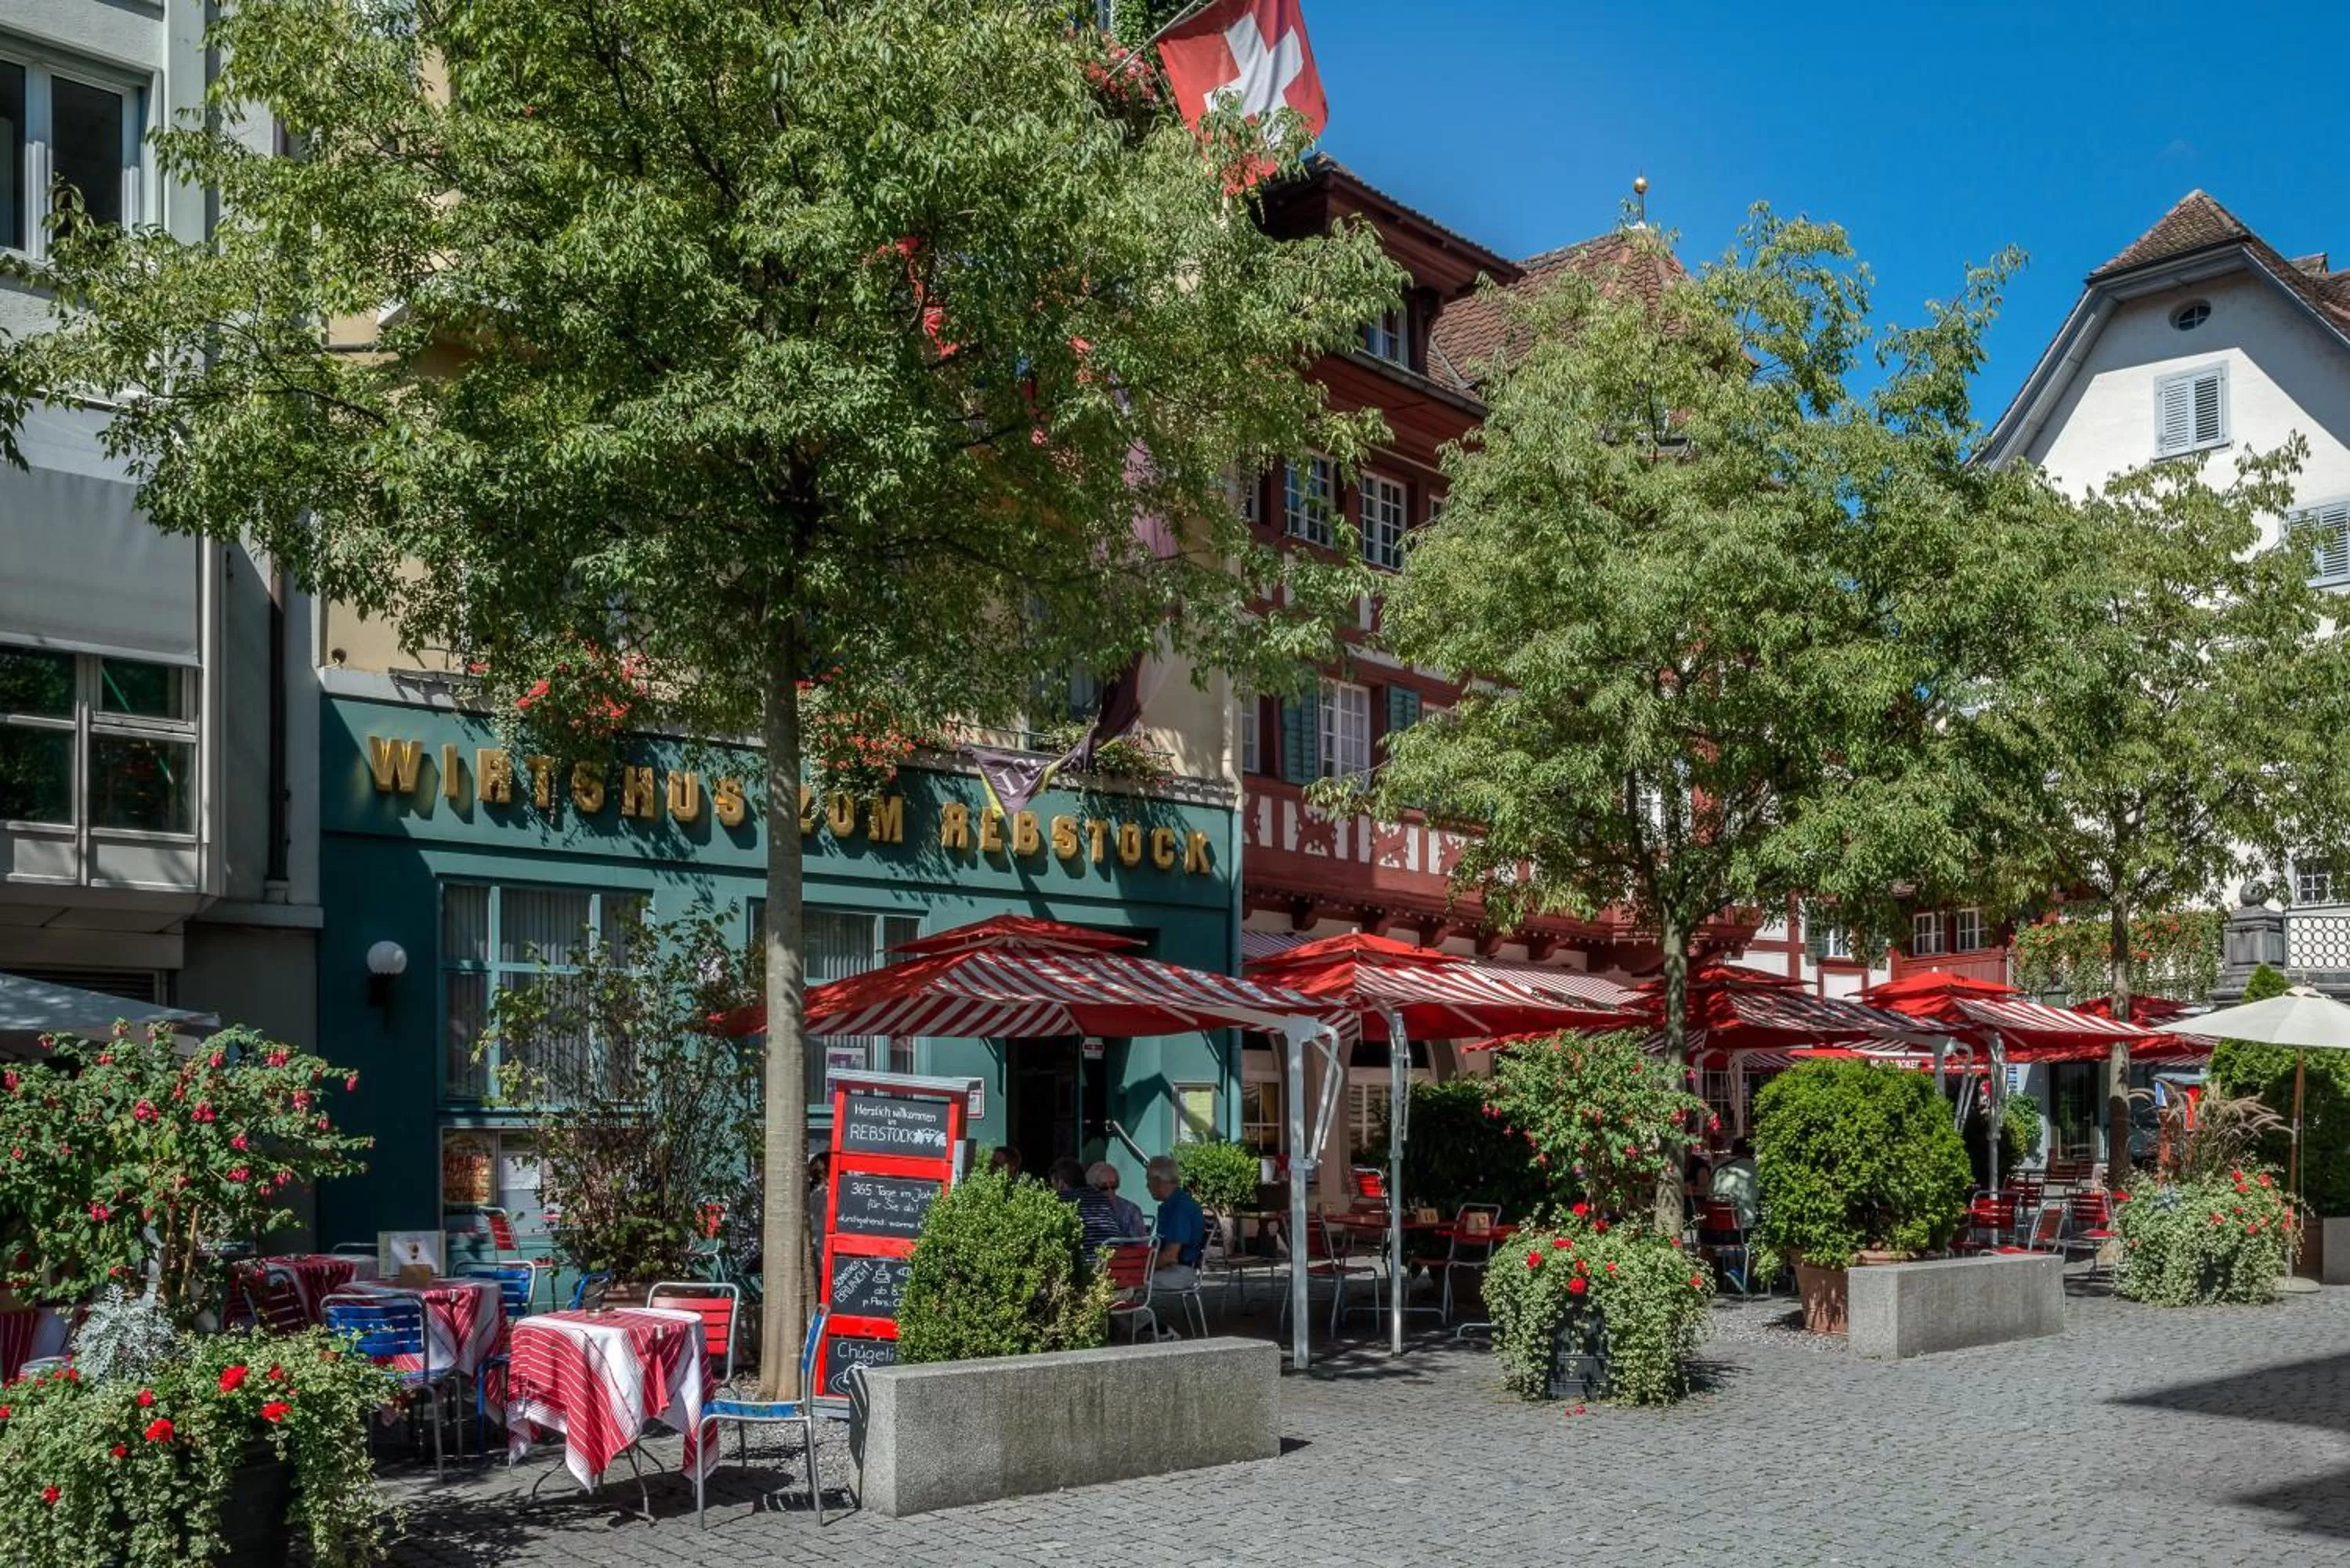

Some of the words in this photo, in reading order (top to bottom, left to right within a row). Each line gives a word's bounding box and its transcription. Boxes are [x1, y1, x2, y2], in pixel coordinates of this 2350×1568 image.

[367, 735, 745, 826] WIRTSHUS
[942, 800, 1213, 874] REBSTOCK
[854, 1103, 891, 1118] Herzlich
[850, 1123, 916, 1143] REBSTOCK
[851, 1182, 872, 1196] 365
[876, 1184, 897, 1201] Tage
[883, 1198, 898, 1212] Sie
[873, 1286, 888, 1295] ab
